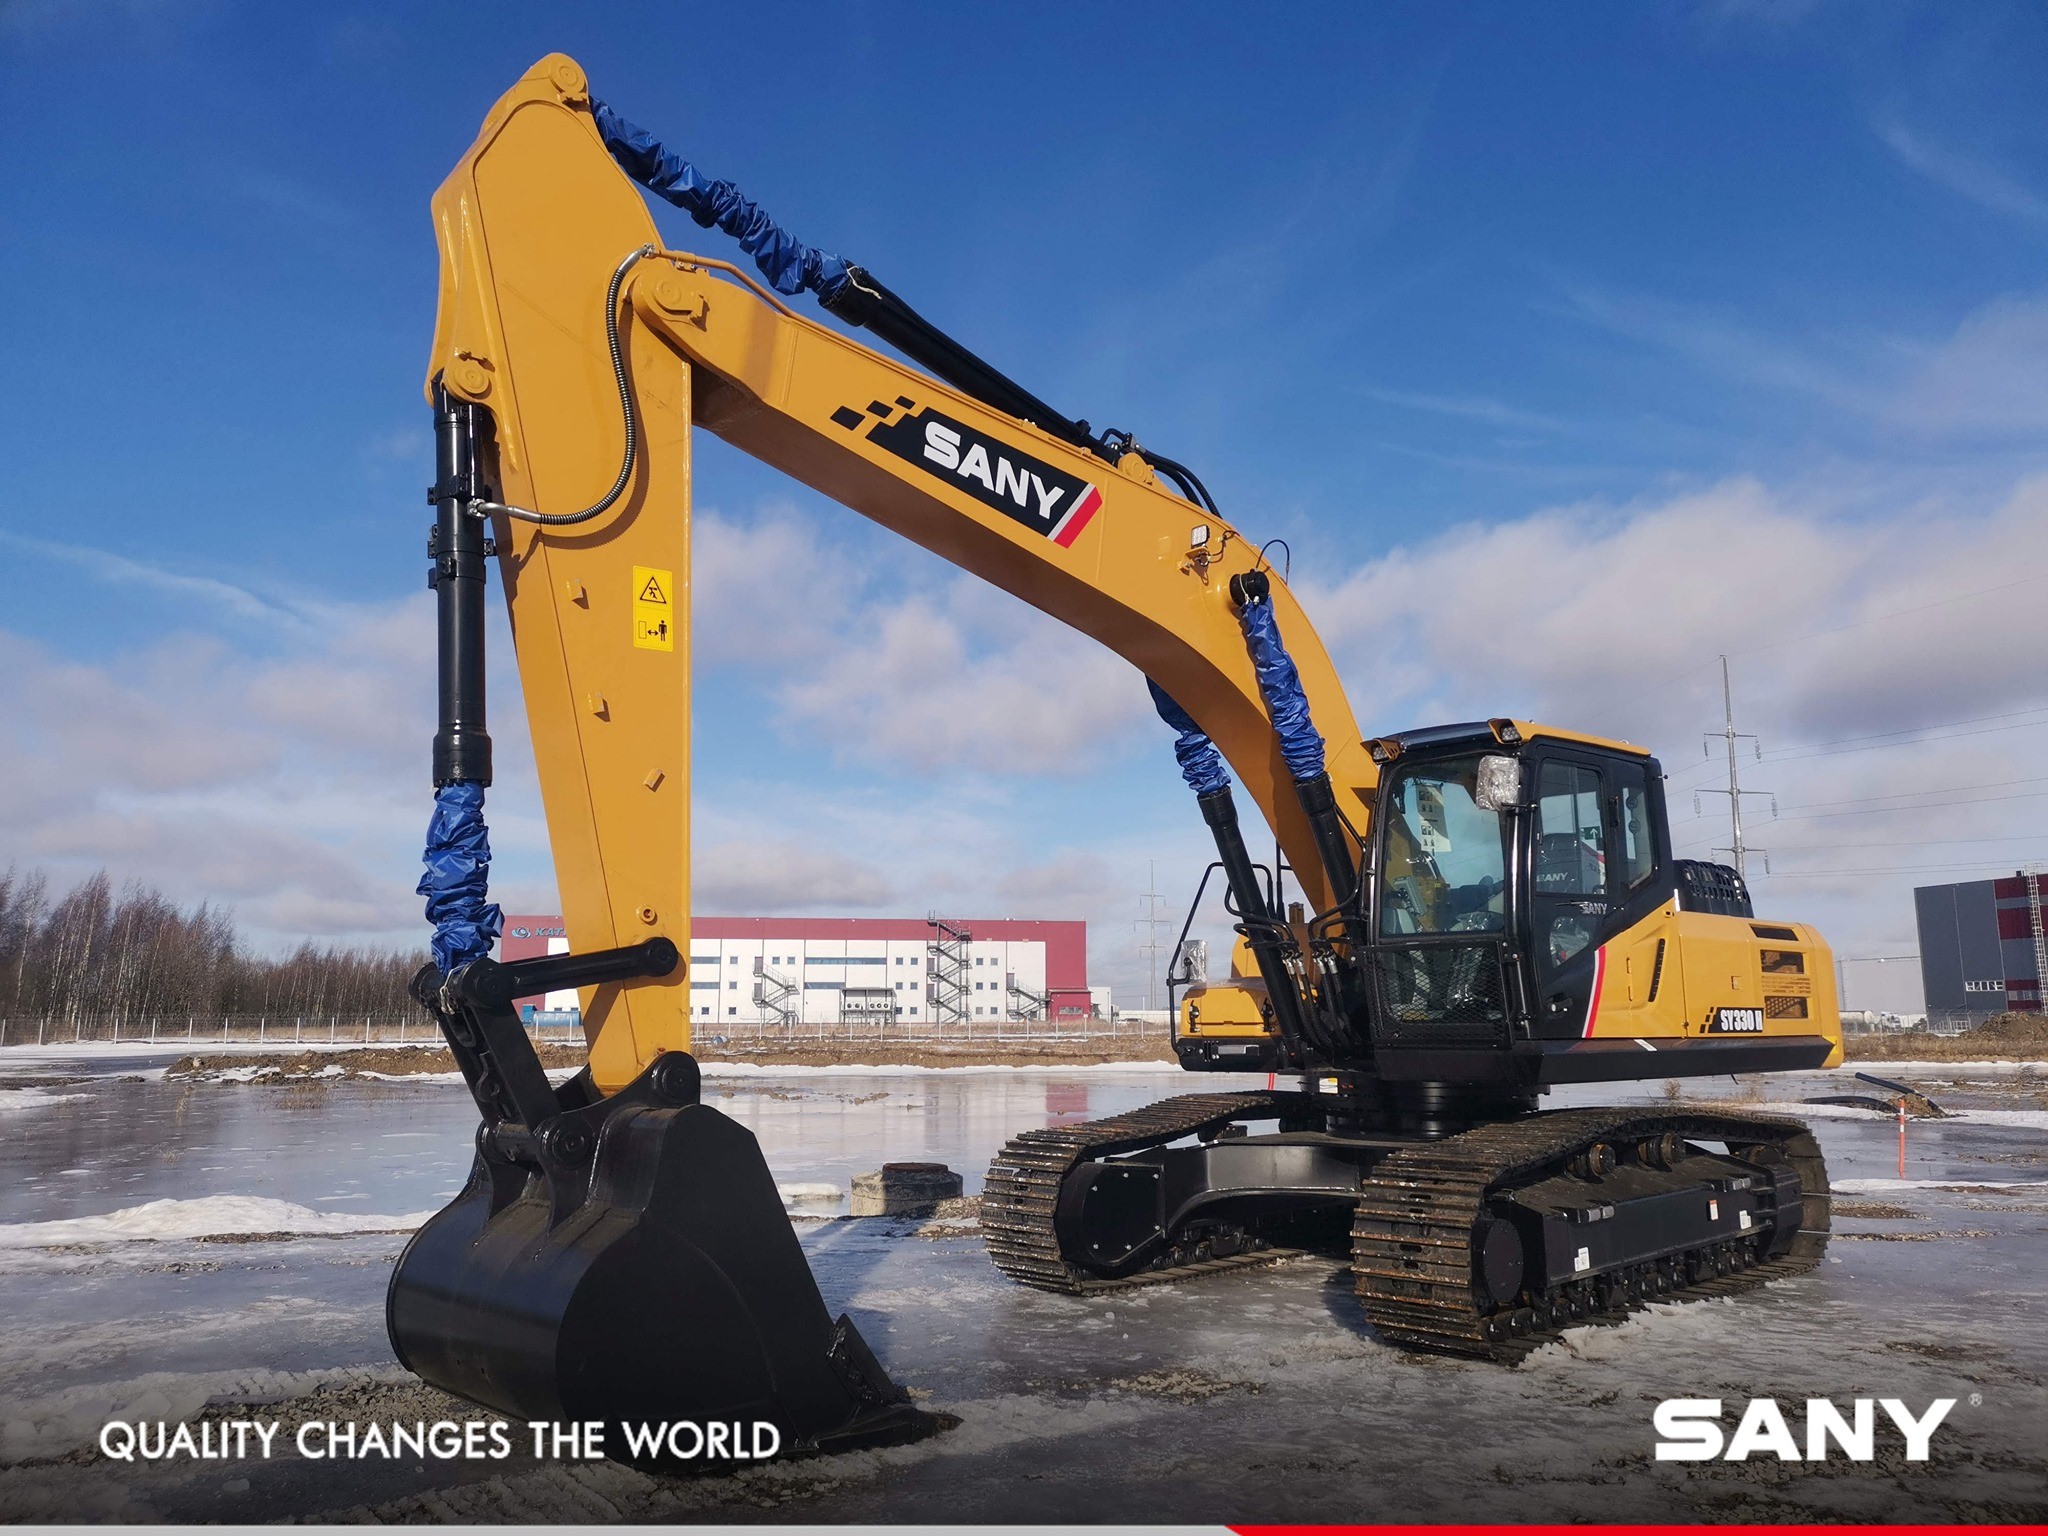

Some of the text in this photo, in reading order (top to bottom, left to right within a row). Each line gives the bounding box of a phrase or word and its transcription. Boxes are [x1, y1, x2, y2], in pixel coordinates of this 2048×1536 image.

[923, 421, 1065, 519] SANY
[1580, 902, 1607, 915] SANY
[1720, 1009, 1755, 1031] SY330
